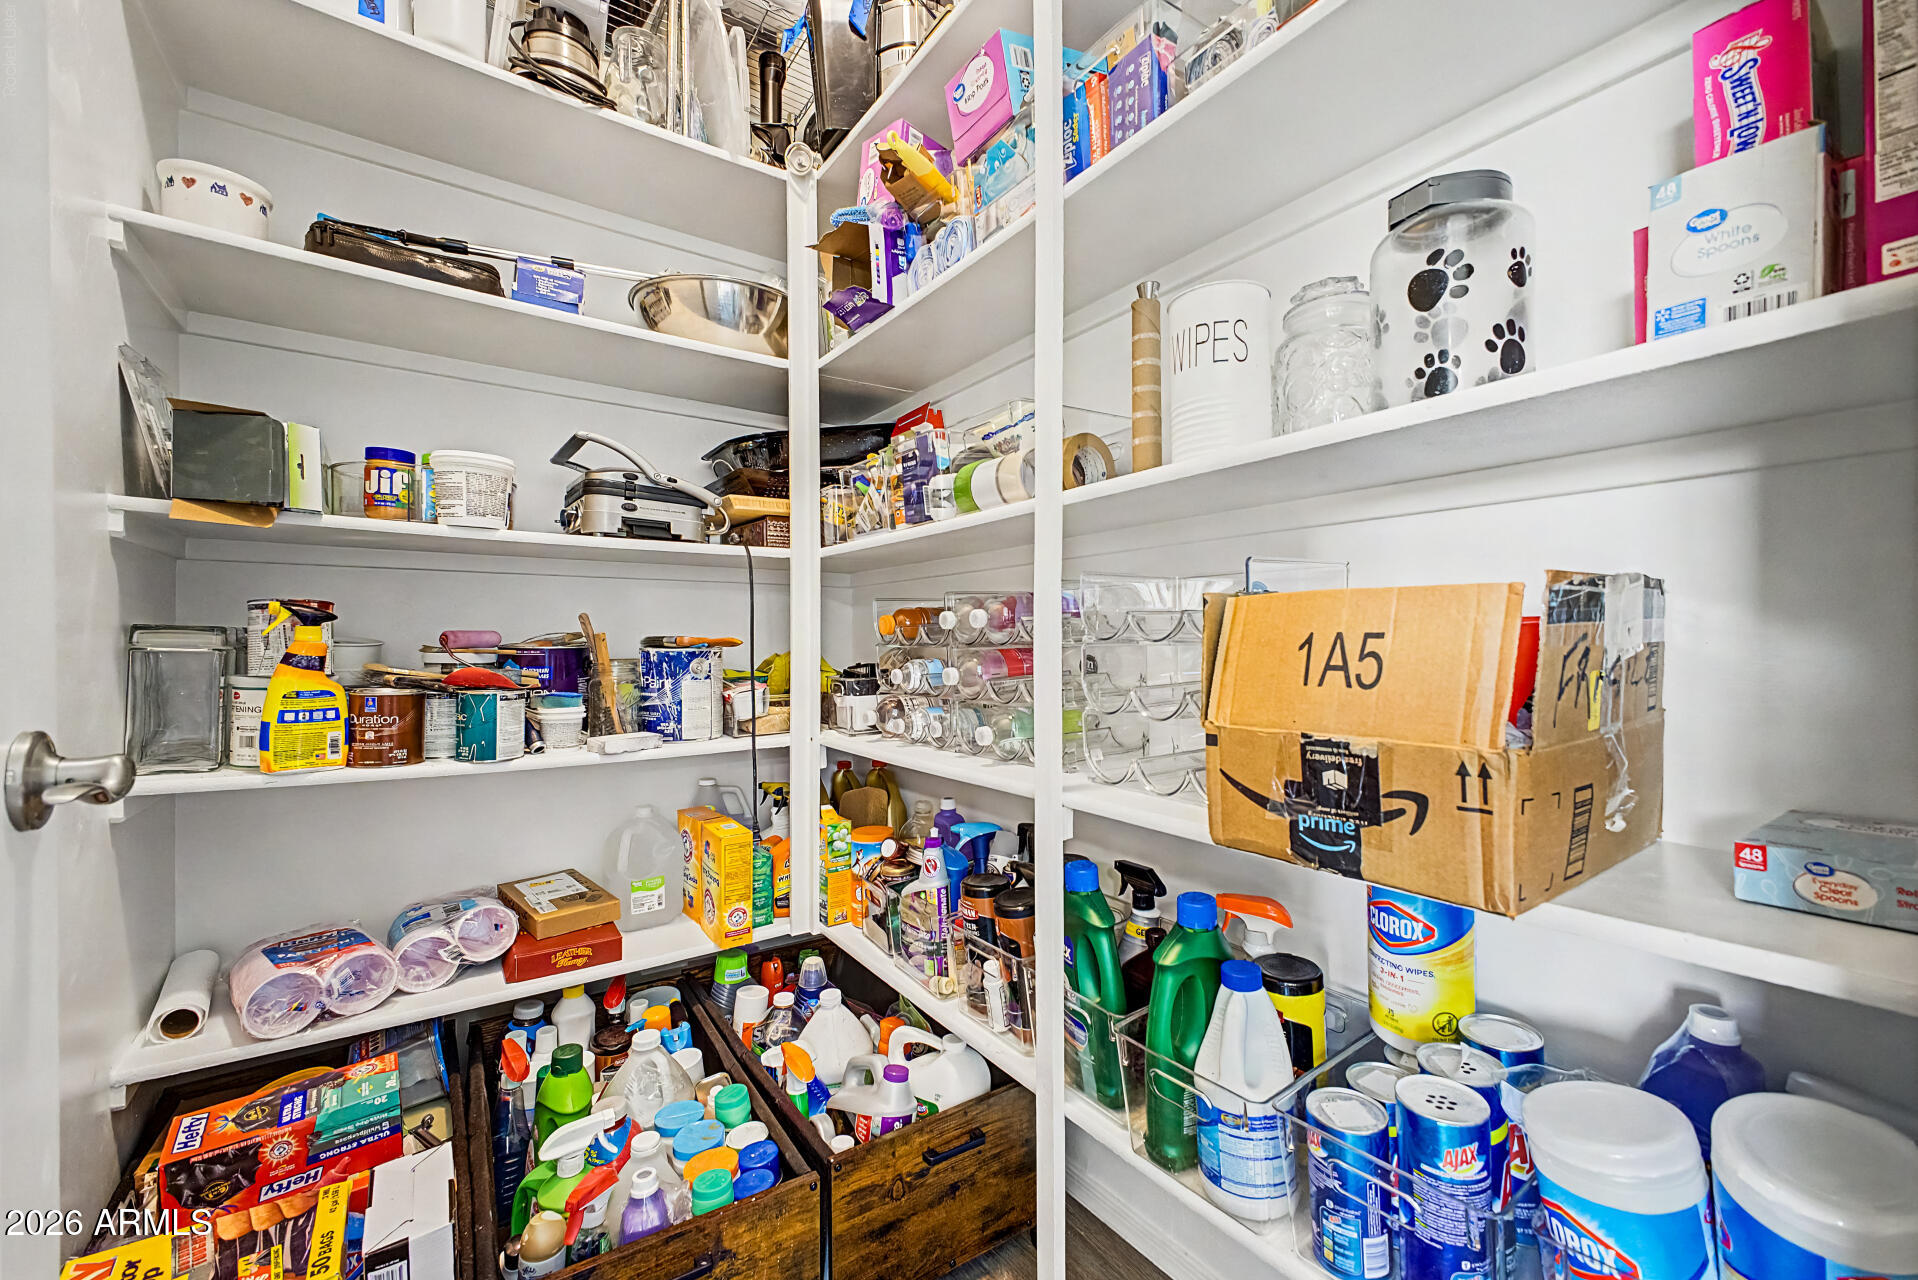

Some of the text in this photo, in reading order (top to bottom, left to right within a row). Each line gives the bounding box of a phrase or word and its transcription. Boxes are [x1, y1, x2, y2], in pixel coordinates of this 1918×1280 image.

[1705, 225, 1753, 244] White
[1171, 319, 1249, 376] WIPES
[364, 469, 411, 495] Jif
[1297, 631, 1386, 690] 1A5
[1306, 751, 1342, 766] delivery
[1297, 813, 1355, 836] prime
[1739, 847, 1764, 863] 48
[1812, 877, 1859, 891] Everyday
[1818, 885, 1853, 898] Clear
[1368, 908, 1424, 943] CLOROX
[551, 947, 593, 963] LEATHER
[1405, 967, 1434, 979] WIPES
[176, 1114, 205, 1152] Hefty
[319, 1129, 390, 1159] ULTRA STRONG
[1442, 1144, 1478, 1172] AJAX
[263, 1170, 319, 1198] Hefty
[310, 1230, 335, 1278] 50 BAGS
[1546, 1211, 1621, 1279] LOROX
